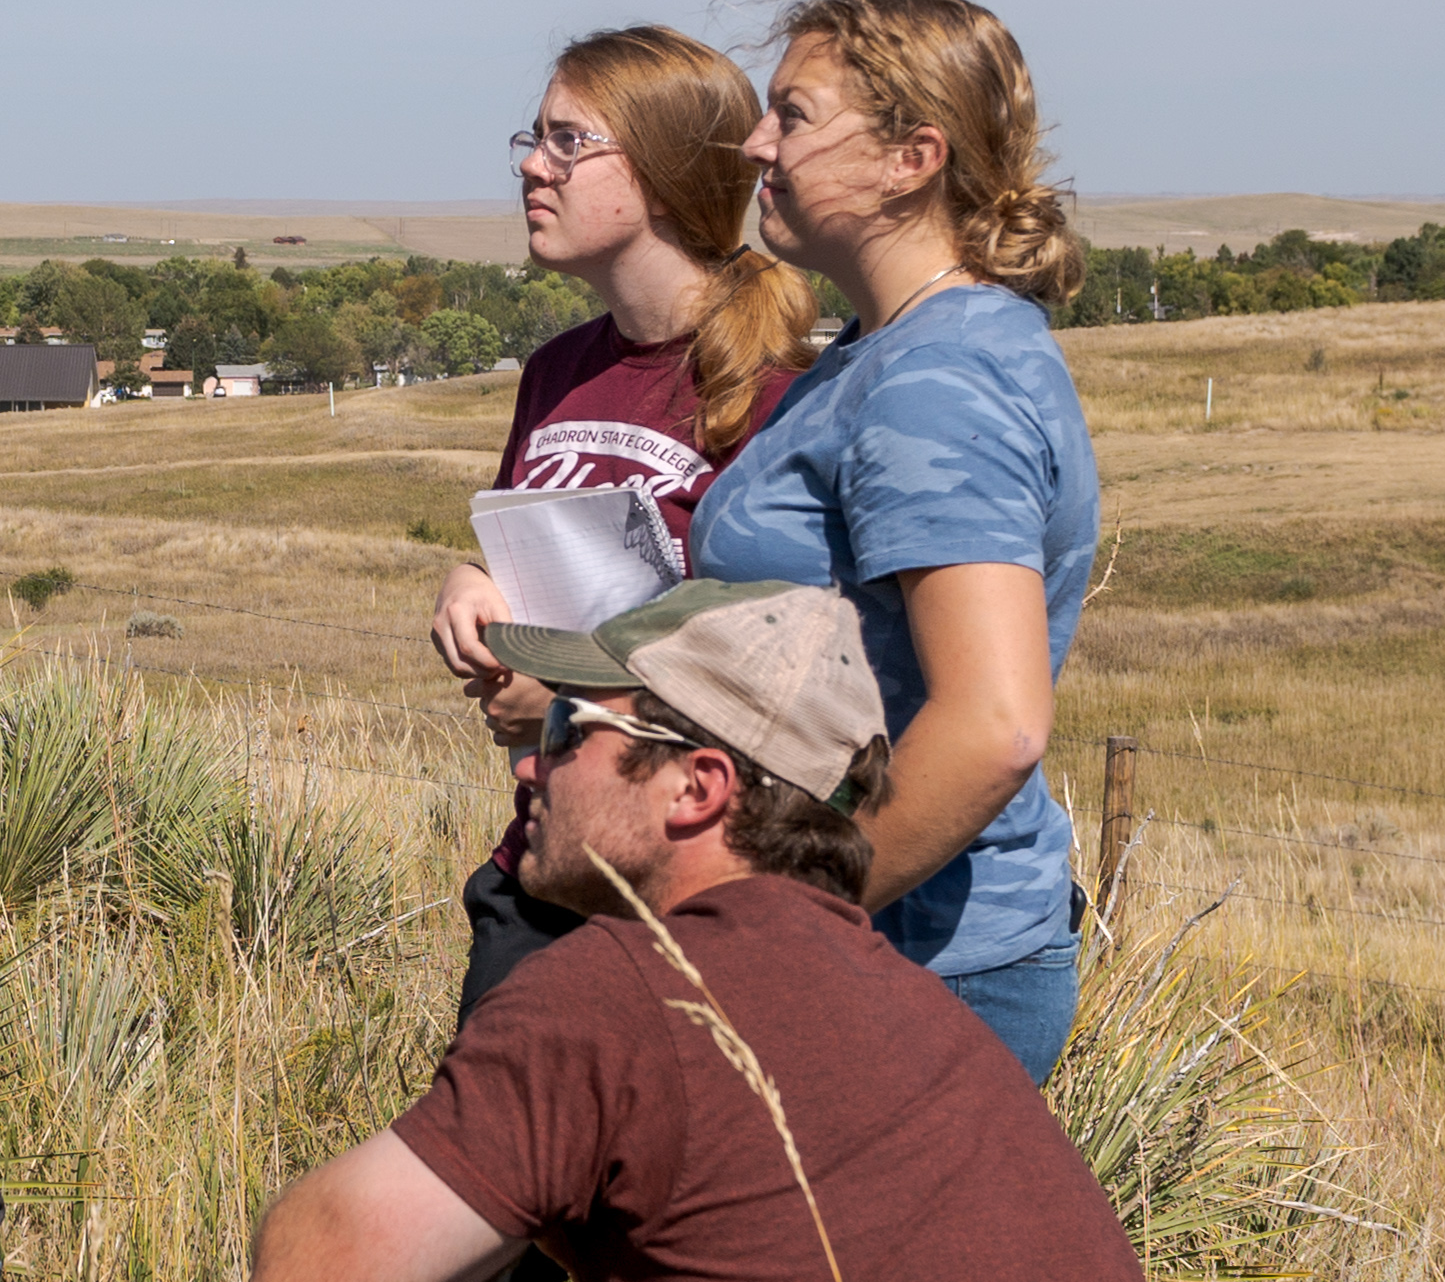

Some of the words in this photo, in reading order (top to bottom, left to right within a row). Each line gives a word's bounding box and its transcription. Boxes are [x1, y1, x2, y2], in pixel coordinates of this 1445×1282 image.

[536, 430, 598, 449] CHADRON
[600, 431, 636, 449] STATE
[634, 436, 697, 478] COLLEGE
